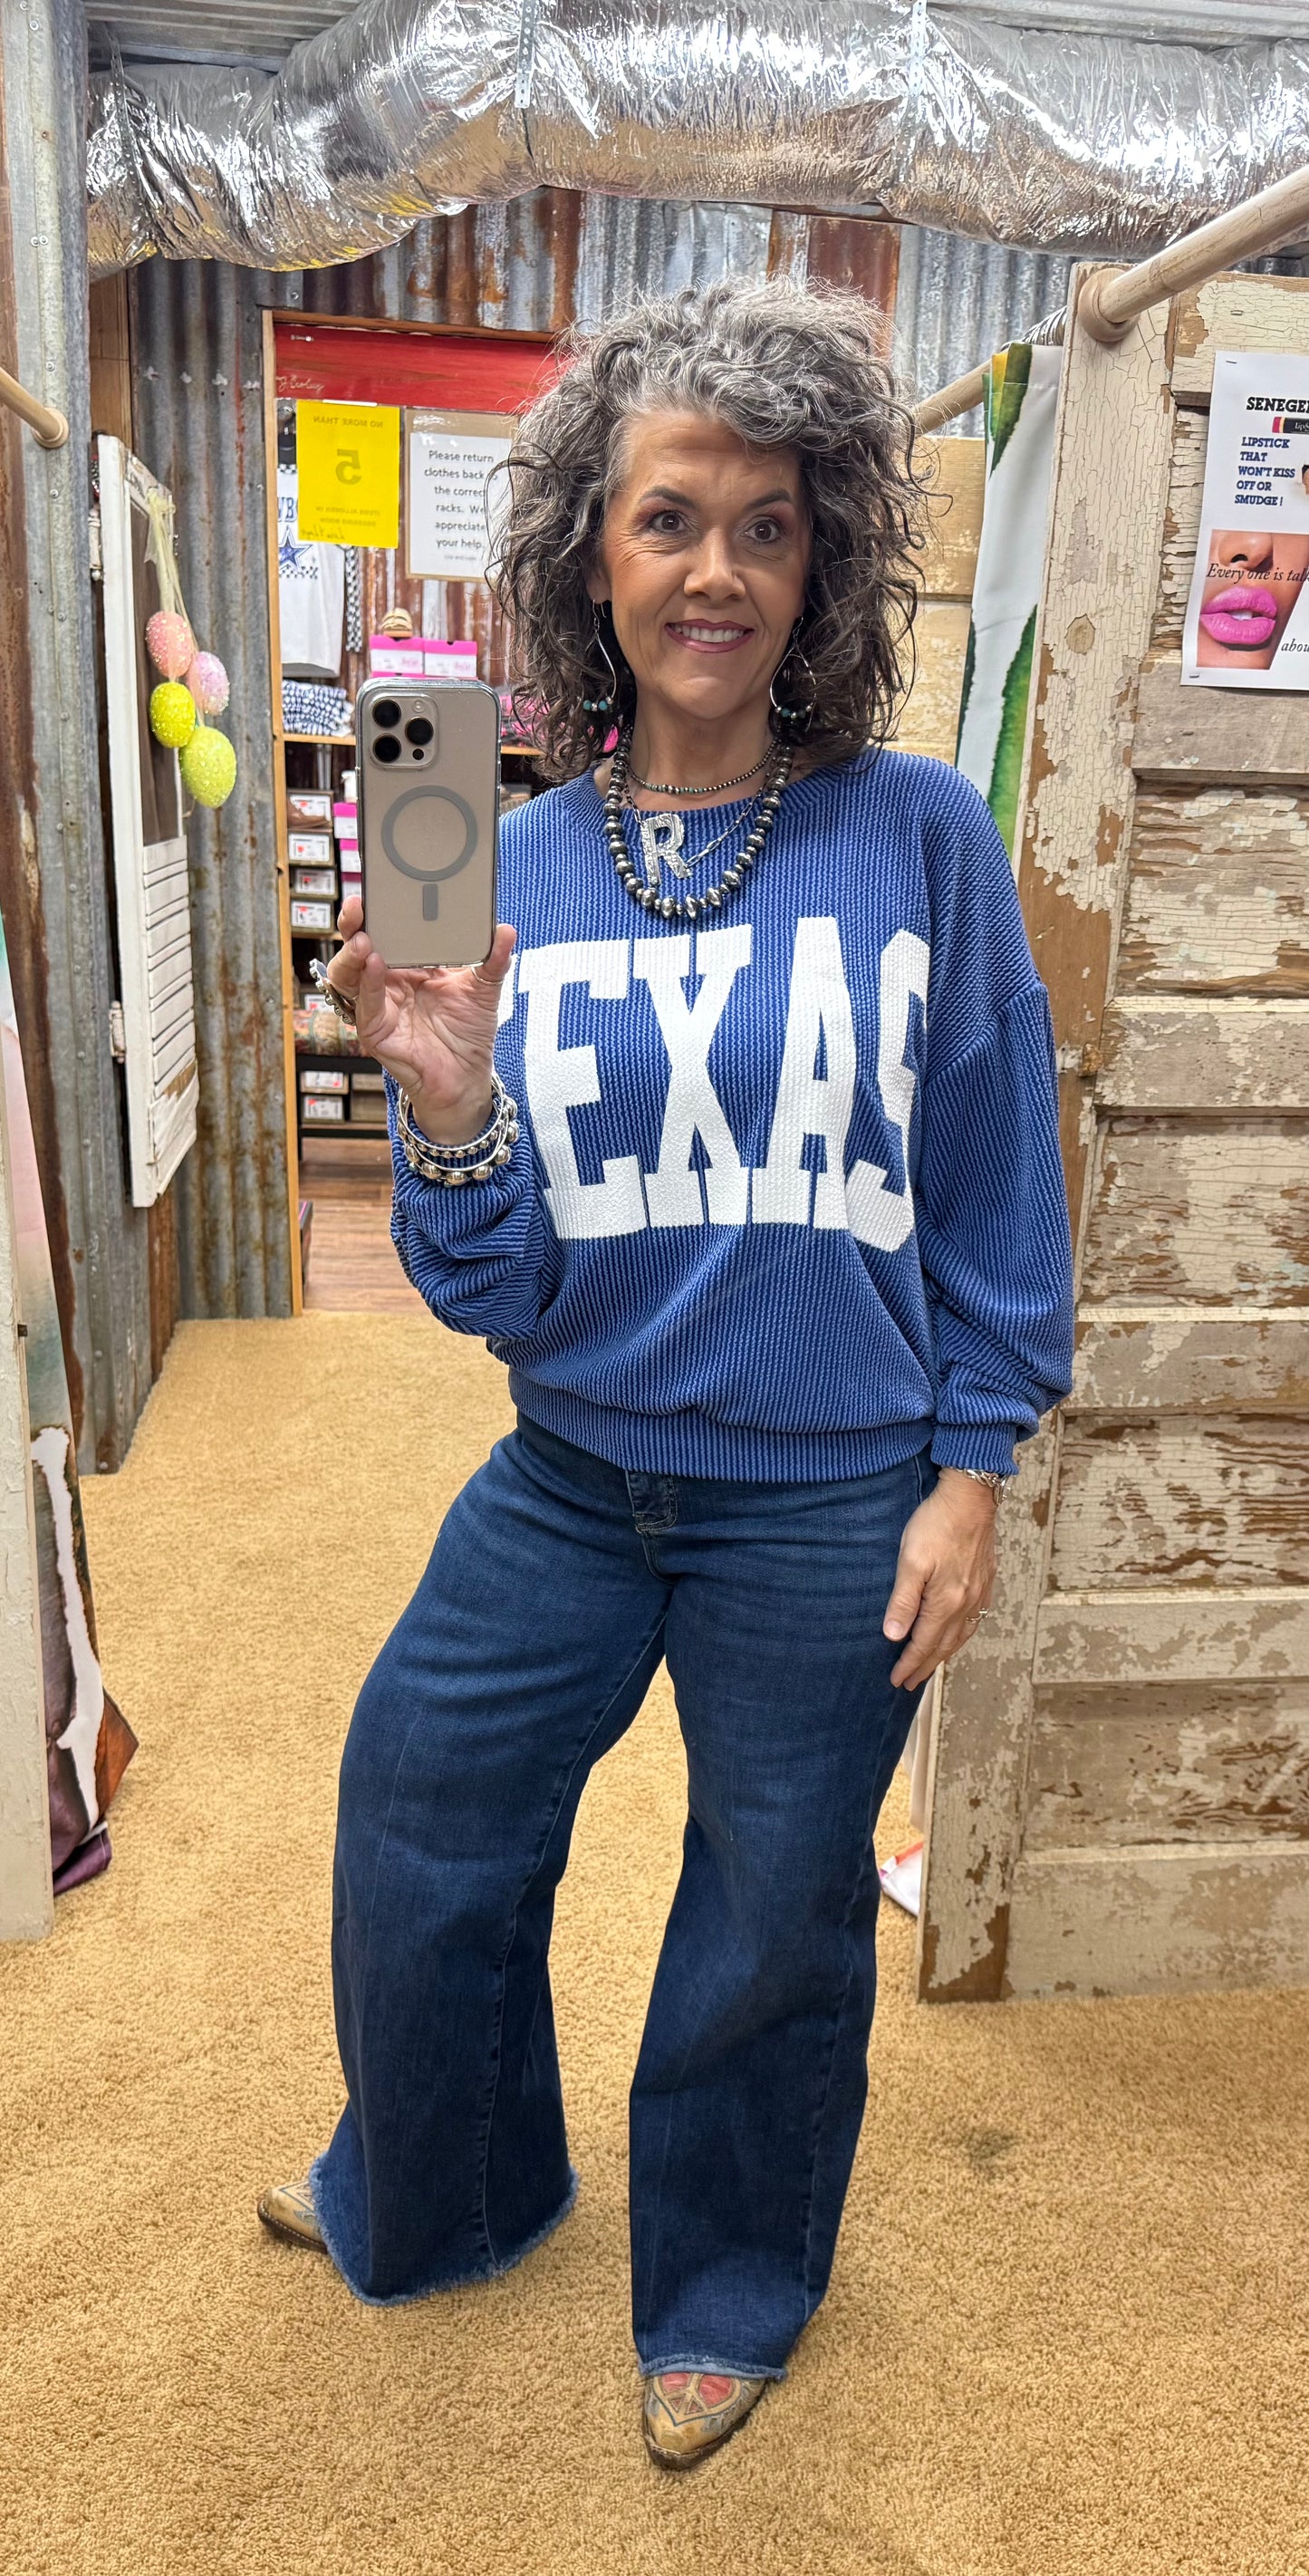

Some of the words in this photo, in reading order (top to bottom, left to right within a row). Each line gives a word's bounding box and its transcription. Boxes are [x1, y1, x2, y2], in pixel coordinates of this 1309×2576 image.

[1241, 437, 1290, 449] LIPSTICK
[428, 450, 460, 460] Please
[463, 453, 494, 463] return
[1240, 451, 1267, 461] THAT
[424, 468, 459, 478] clothes
[462, 469, 485, 479] back
[1238, 466, 1272, 477] WON'T
[1273, 468, 1295, 478] KISS
[435, 486, 450, 495] the
[1237, 480, 1256, 490] OFF
[1256, 481, 1272, 491] OR
[1235, 494, 1278, 506] SMUDGE
[436, 504, 464, 513] racks.
[469, 506, 486, 514] We
[435, 521, 486, 531] appreciate
[437, 538, 457, 548] your
[1206, 563, 1245, 584] Every
[1247, 570, 1271, 580] one
[1273, 567, 1284, 581] is
[640, 813, 693, 887] R
